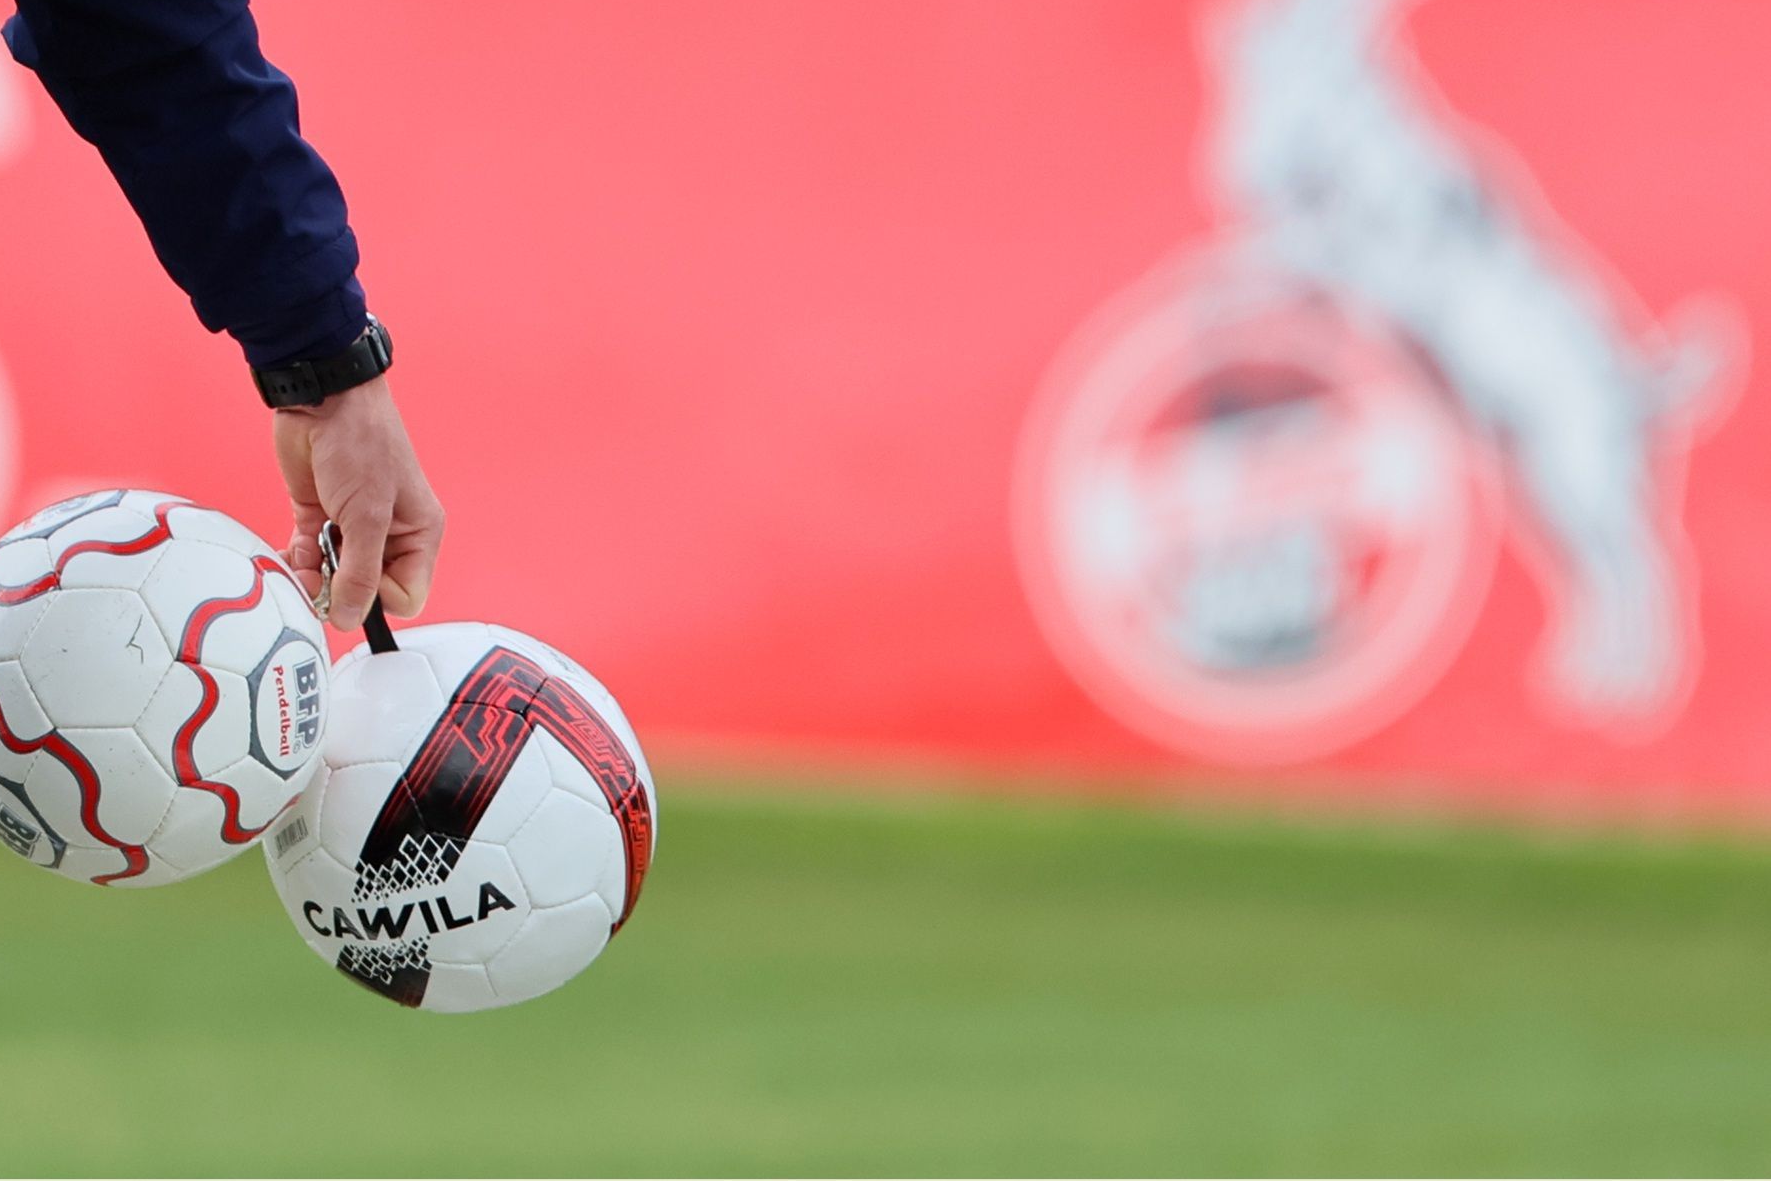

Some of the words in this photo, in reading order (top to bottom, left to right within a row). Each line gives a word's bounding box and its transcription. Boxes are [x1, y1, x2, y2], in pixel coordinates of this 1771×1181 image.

[272, 664, 290, 757] Pendelball
[292, 656, 321, 750] BFP
[302, 880, 518, 941] CAWILA
